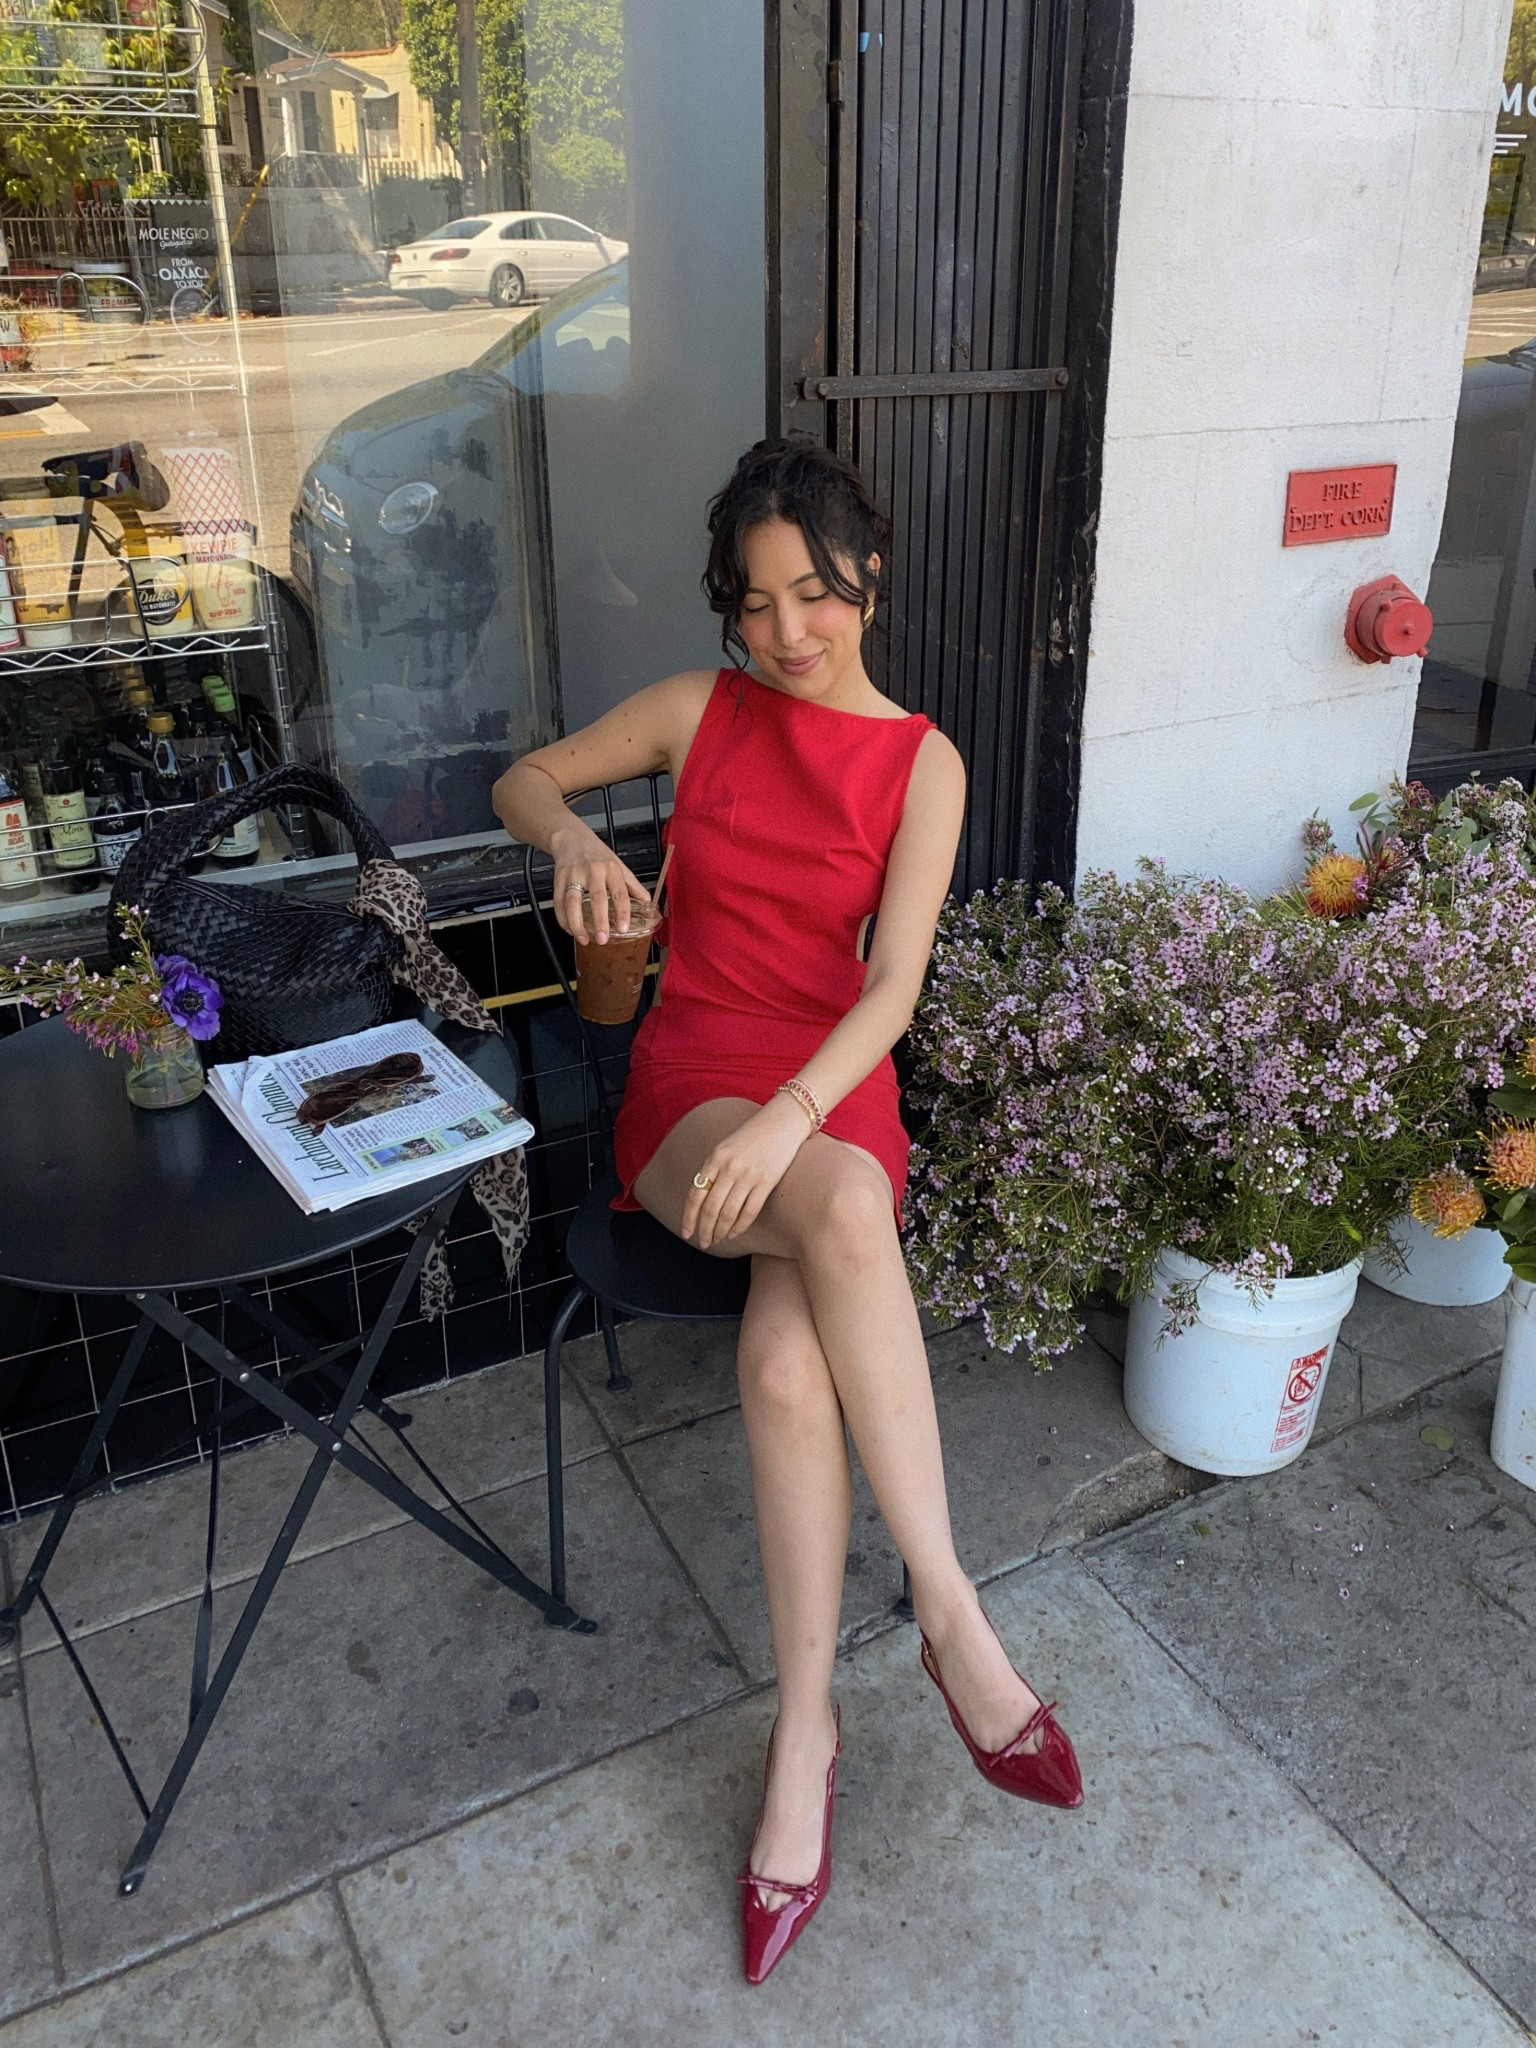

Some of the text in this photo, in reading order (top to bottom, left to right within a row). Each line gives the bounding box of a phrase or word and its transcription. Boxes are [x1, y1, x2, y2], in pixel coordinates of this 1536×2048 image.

[139, 228, 209, 241] MOLE NEGRO
[171, 258, 195, 267] FROM
[158, 267, 211, 280] OAXACA
[174, 280, 204, 289] TO YOU
[1323, 482, 1362, 501] FIRE
[191, 537, 238, 554] KEWPIE
[8, 835, 25, 846] BOAT
[280, 1122, 349, 1181] Larchmont
